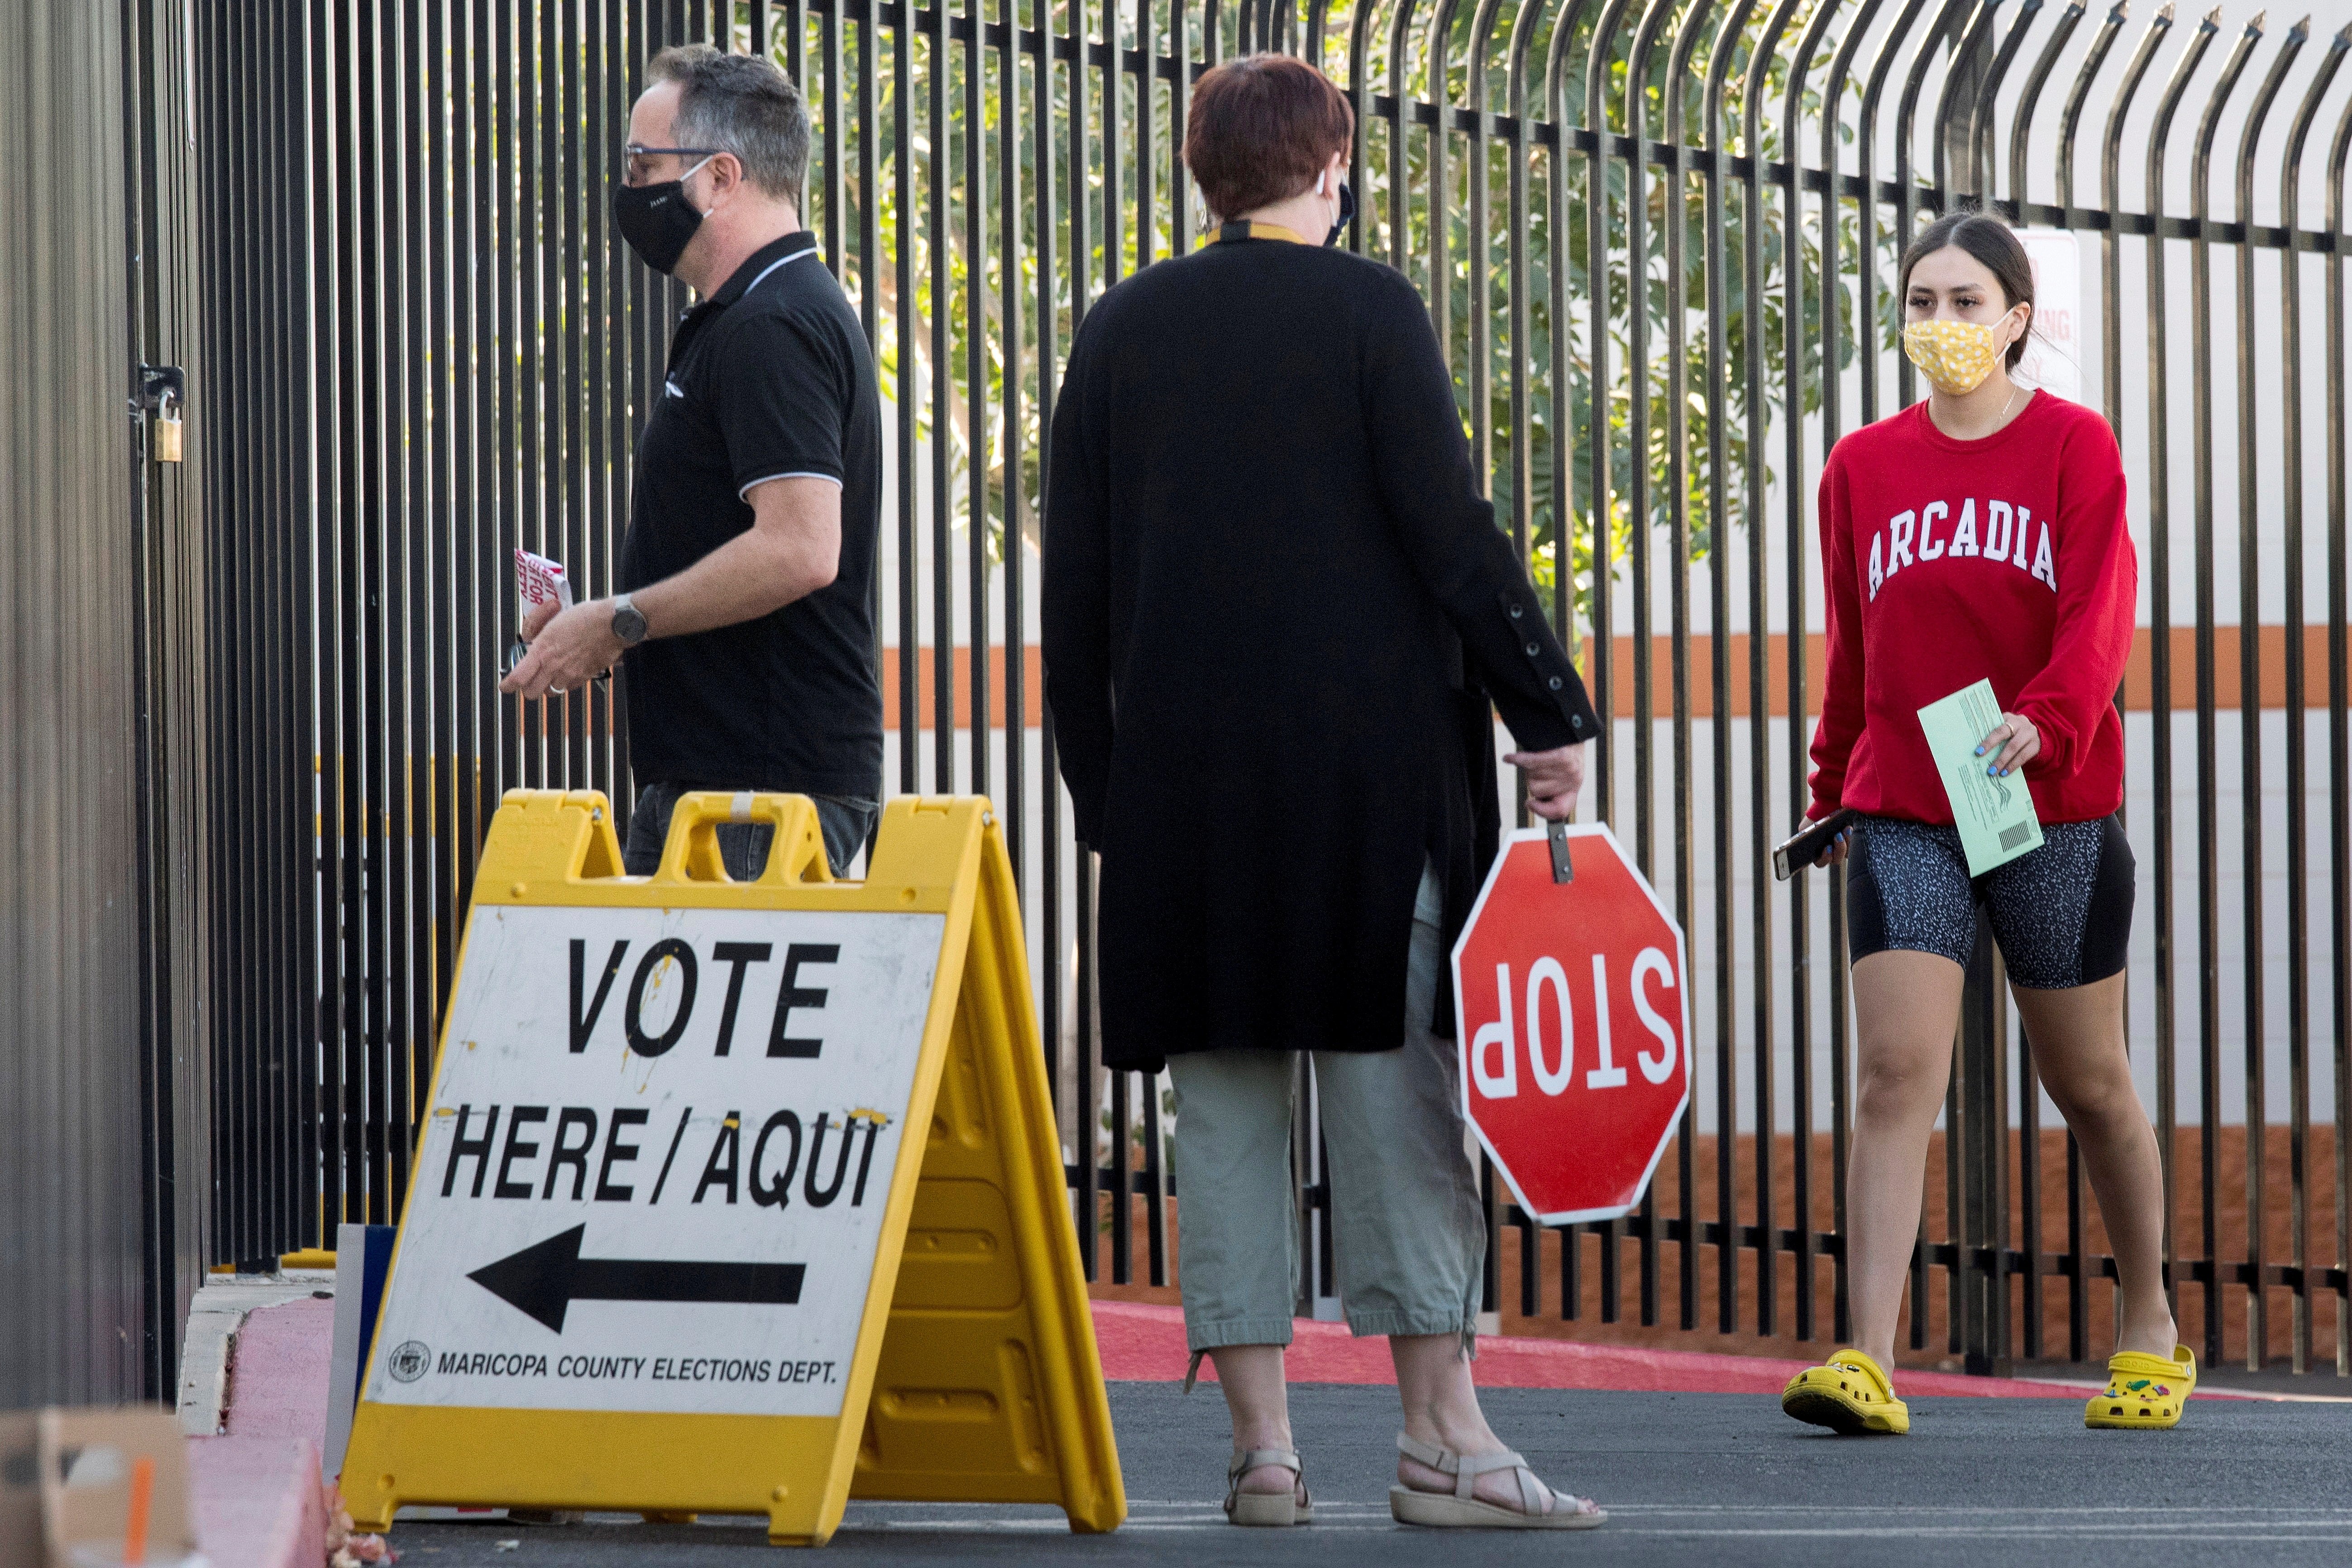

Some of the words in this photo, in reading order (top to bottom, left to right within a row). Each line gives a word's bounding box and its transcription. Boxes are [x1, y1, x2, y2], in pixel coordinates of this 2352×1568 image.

[529, 576, 544, 605] FOR
[1869, 497, 2057, 603] ARCADIA
[569, 937, 841, 1058] VOTE
[1471, 947, 1677, 1099] STOP
[437, 1352, 547, 1376] MARICOPA
[558, 1355, 647, 1379] COUNTY
[652, 1358, 771, 1383] ELECTIONS
[778, 1360, 837, 1384] DEPT.
